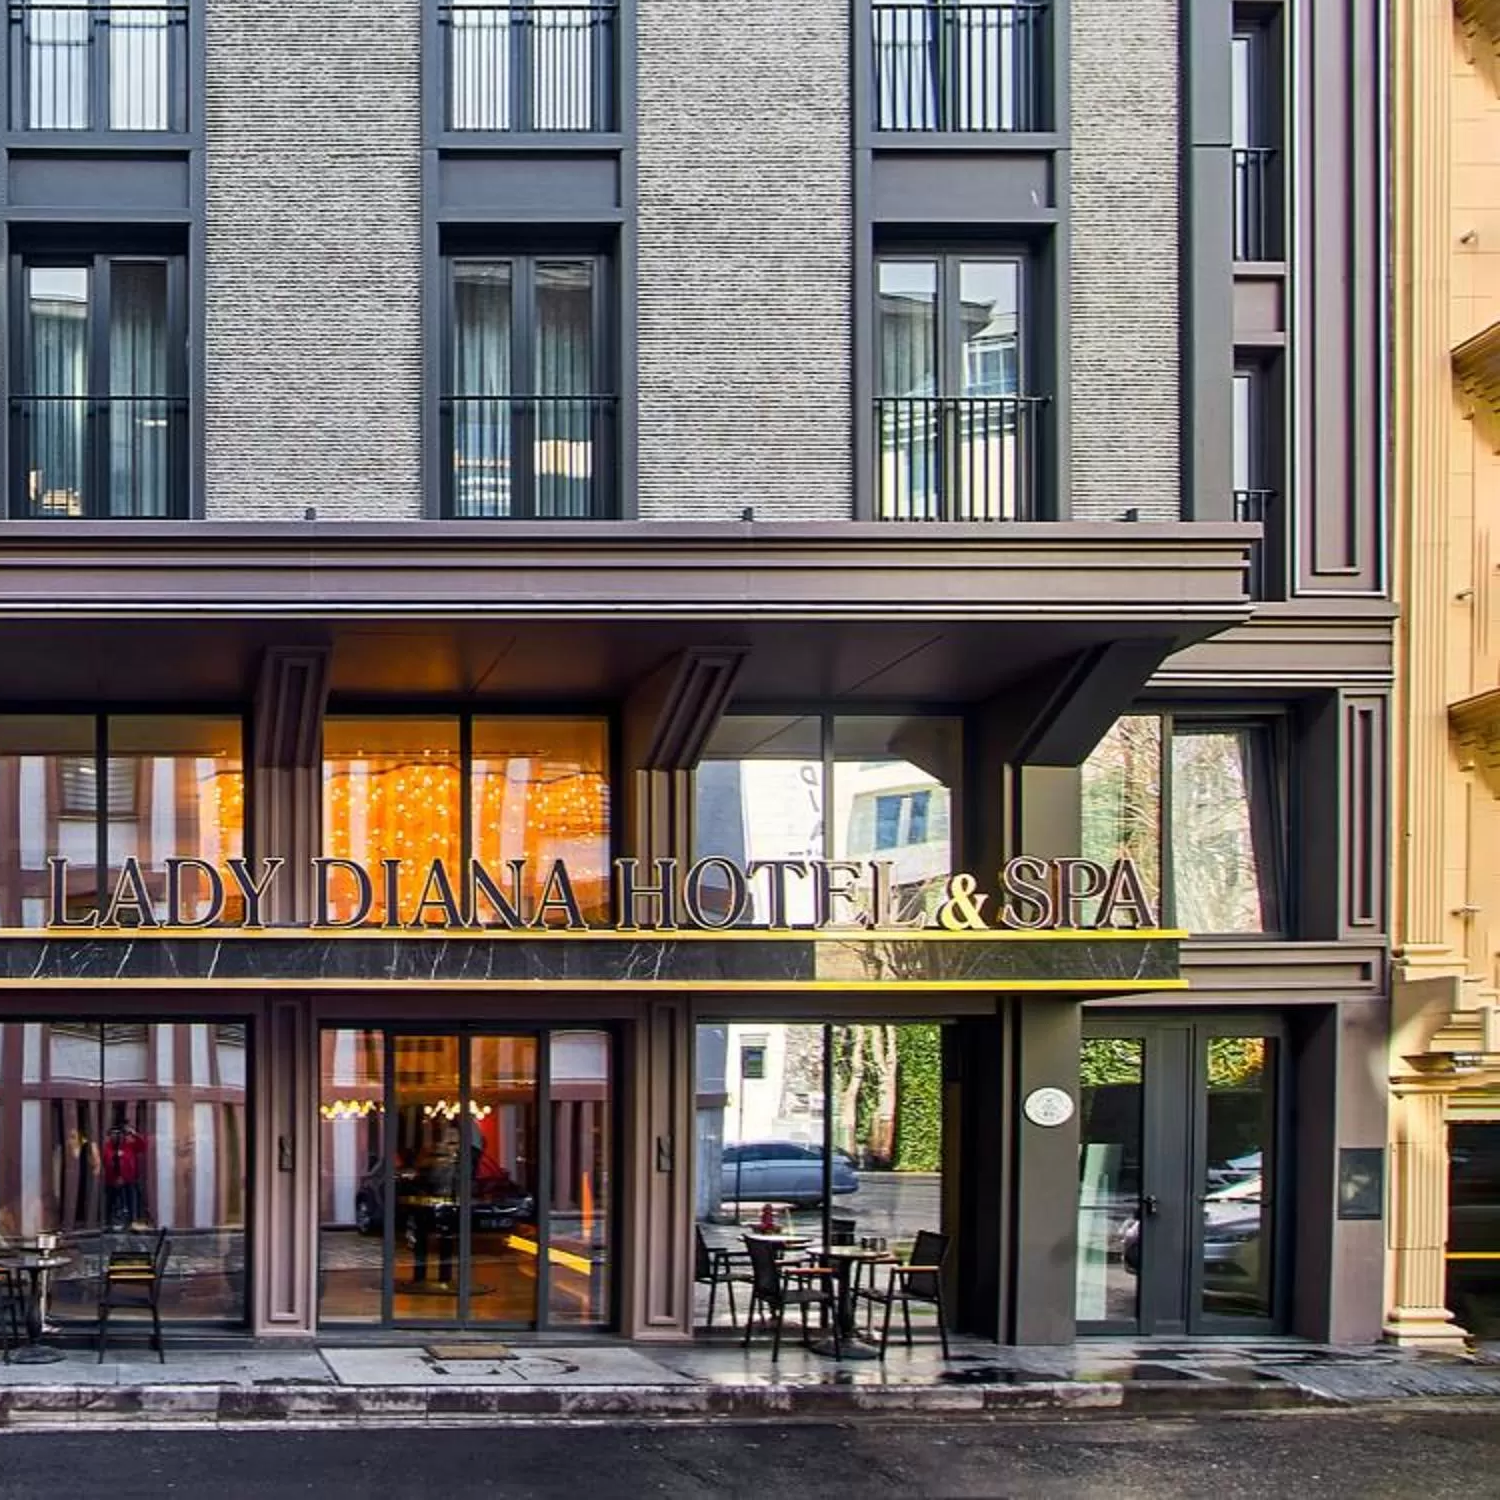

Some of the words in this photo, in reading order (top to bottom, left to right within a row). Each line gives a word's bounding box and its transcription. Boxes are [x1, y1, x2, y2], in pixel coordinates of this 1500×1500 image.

[48, 855, 284, 930] LADY
[310, 855, 589, 931] DIANA
[614, 854, 928, 931] HOTEL
[937, 872, 989, 931] &
[1000, 855, 1159, 931] SPA
